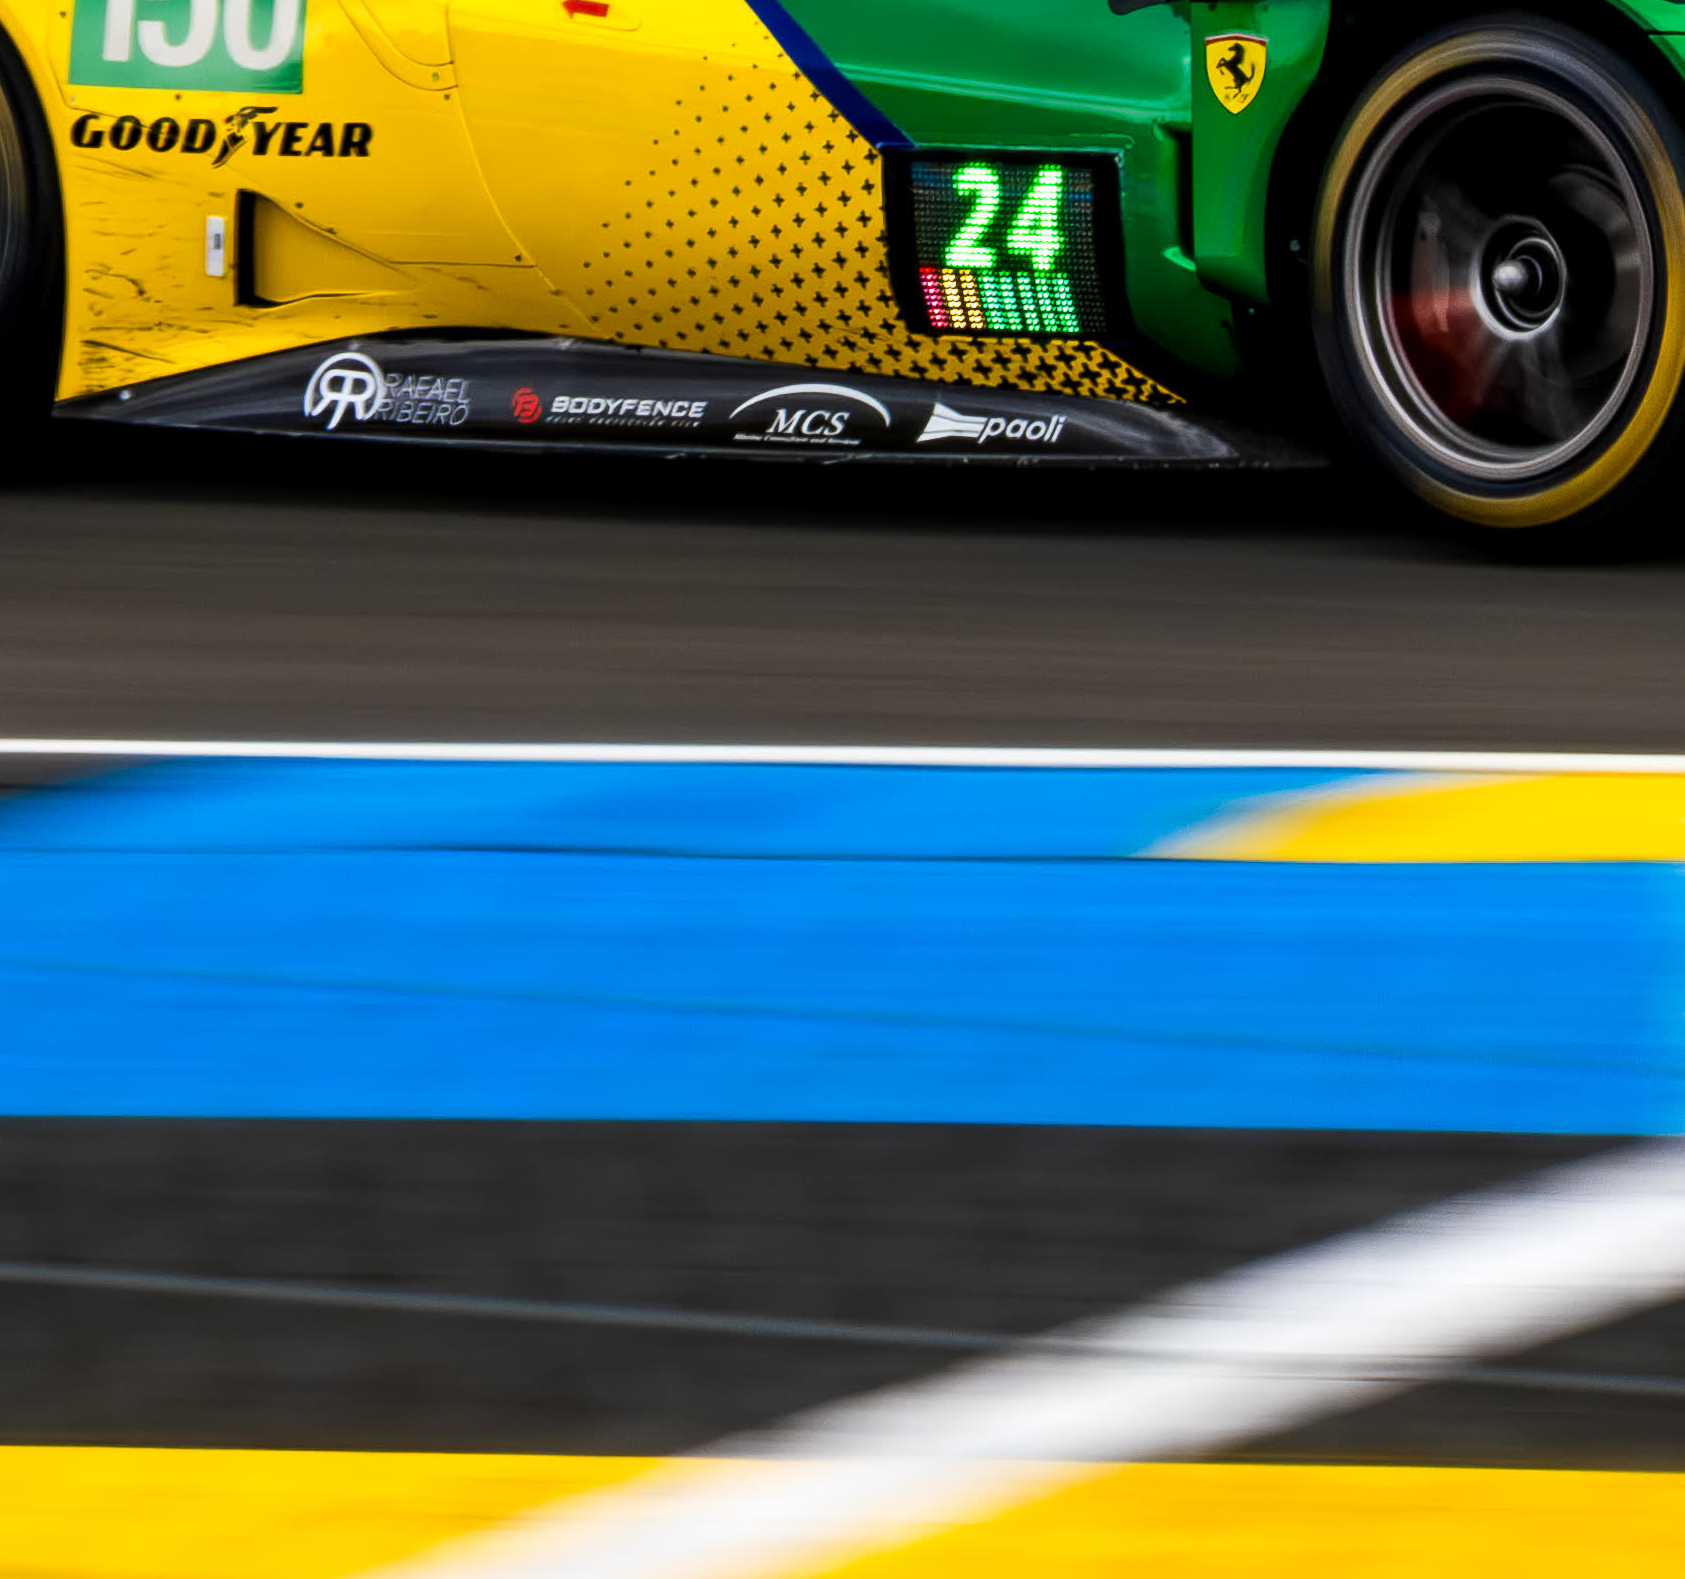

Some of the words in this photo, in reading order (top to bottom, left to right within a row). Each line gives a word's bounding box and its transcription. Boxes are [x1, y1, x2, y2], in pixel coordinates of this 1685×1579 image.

[944, 162, 1067, 270] 24
[382, 373, 472, 404] RAFAEL
[374, 399, 470, 427] RIBEIRO
[550, 395, 709, 419] BODYFENCE
[765, 407, 851, 437] MCS
[978, 415, 1068, 444] paoli
